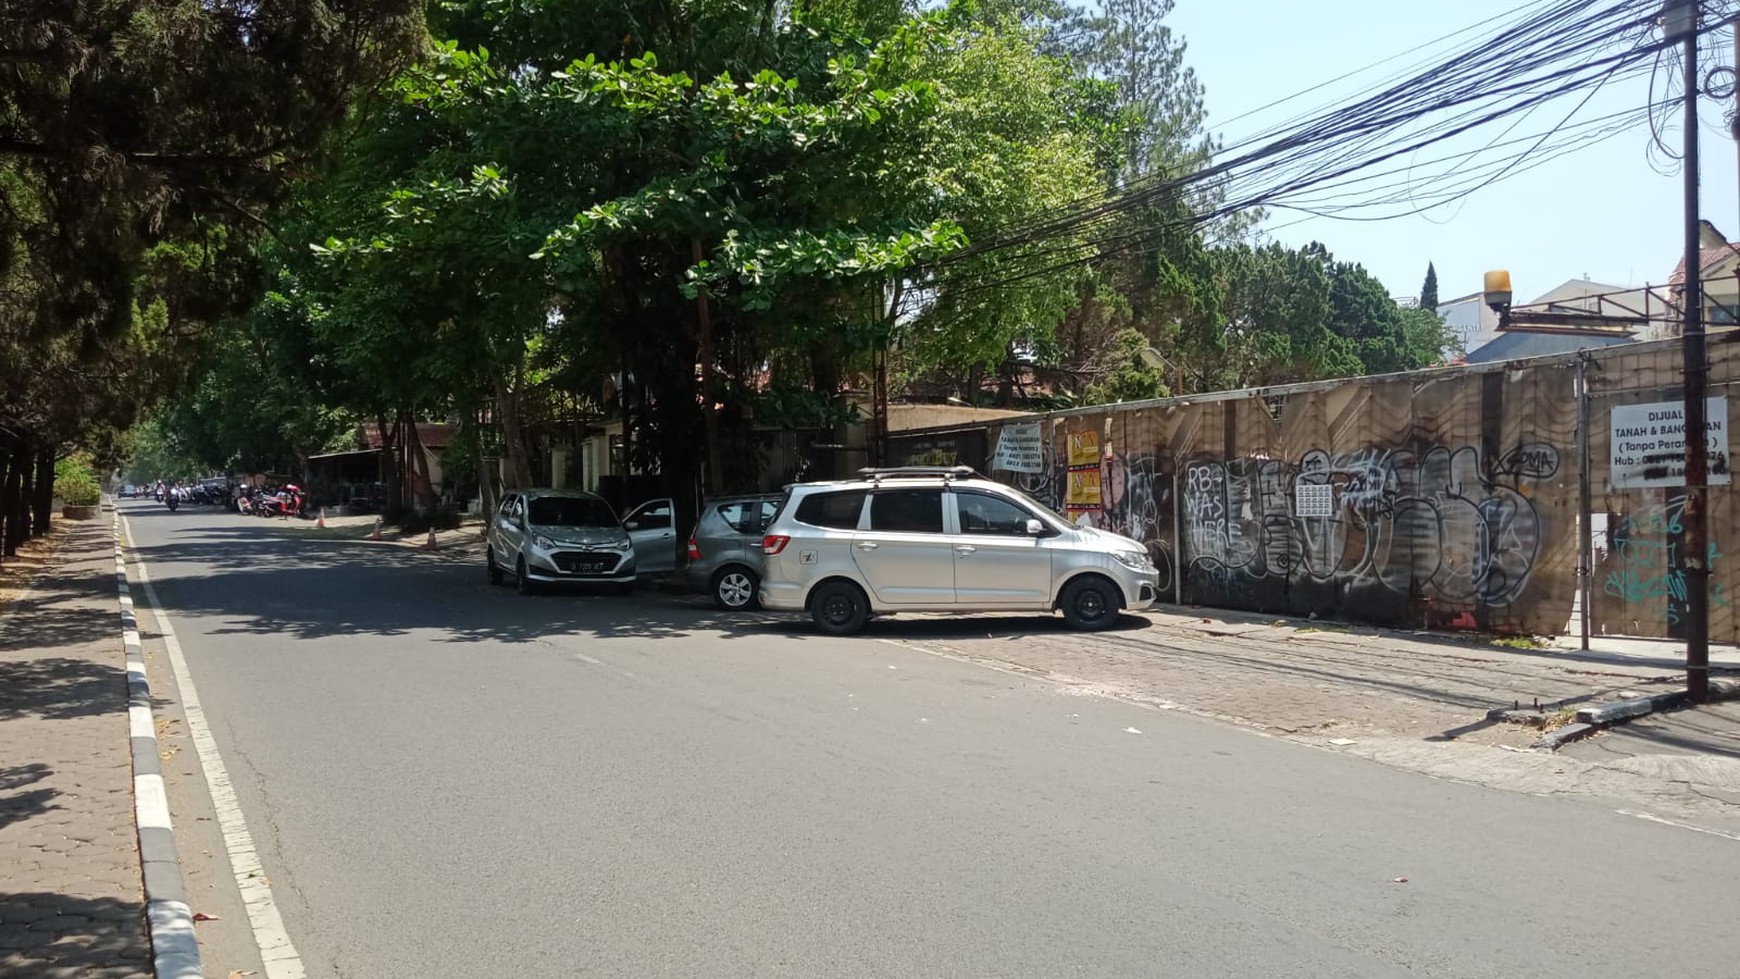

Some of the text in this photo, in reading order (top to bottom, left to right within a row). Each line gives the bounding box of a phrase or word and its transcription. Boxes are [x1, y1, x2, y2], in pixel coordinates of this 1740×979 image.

[1648, 410, 1683, 421] DIJUAL
[1615, 427, 1647, 438] TANAH
[1650, 426, 1657, 435] &
[1184, 491, 1223, 518] WAS
[1192, 517, 1242, 548] HERE
